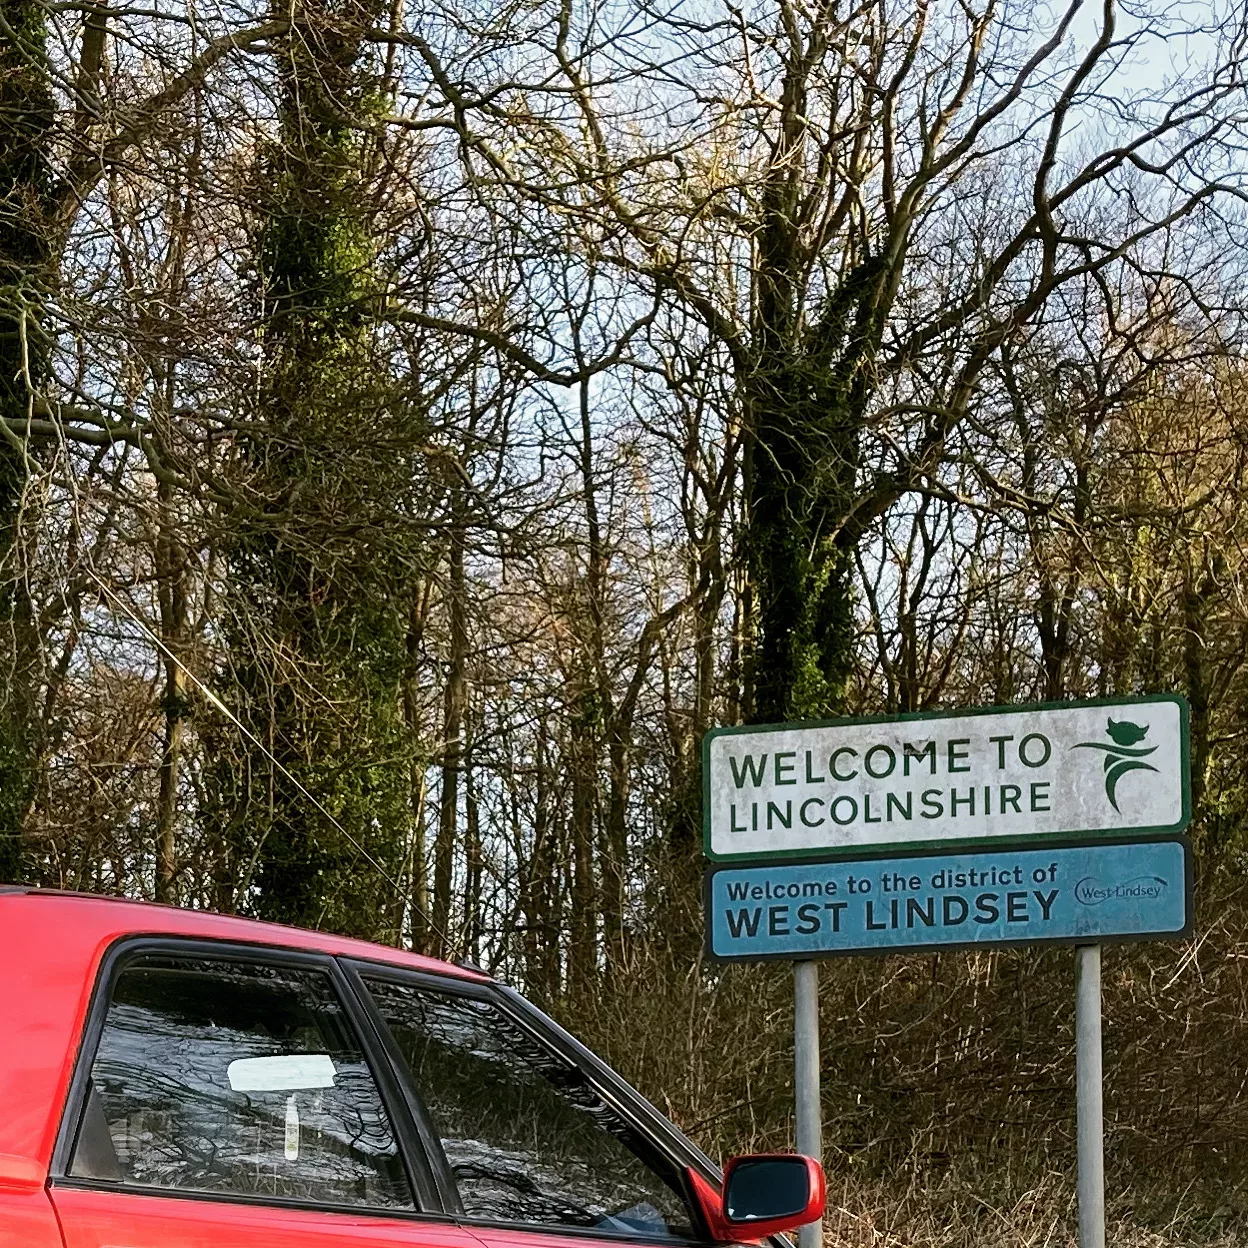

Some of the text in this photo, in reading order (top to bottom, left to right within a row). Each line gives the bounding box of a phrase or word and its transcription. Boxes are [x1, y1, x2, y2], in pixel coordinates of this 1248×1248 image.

[729, 733, 1052, 789] WELCOME TO
[730, 782, 1051, 832] LINCOLNSHIRE
[726, 863, 1059, 902] Welcome to the district of
[1082, 884, 1161, 899] West Lindsey
[725, 889, 1059, 938] WEST LINDSEY
